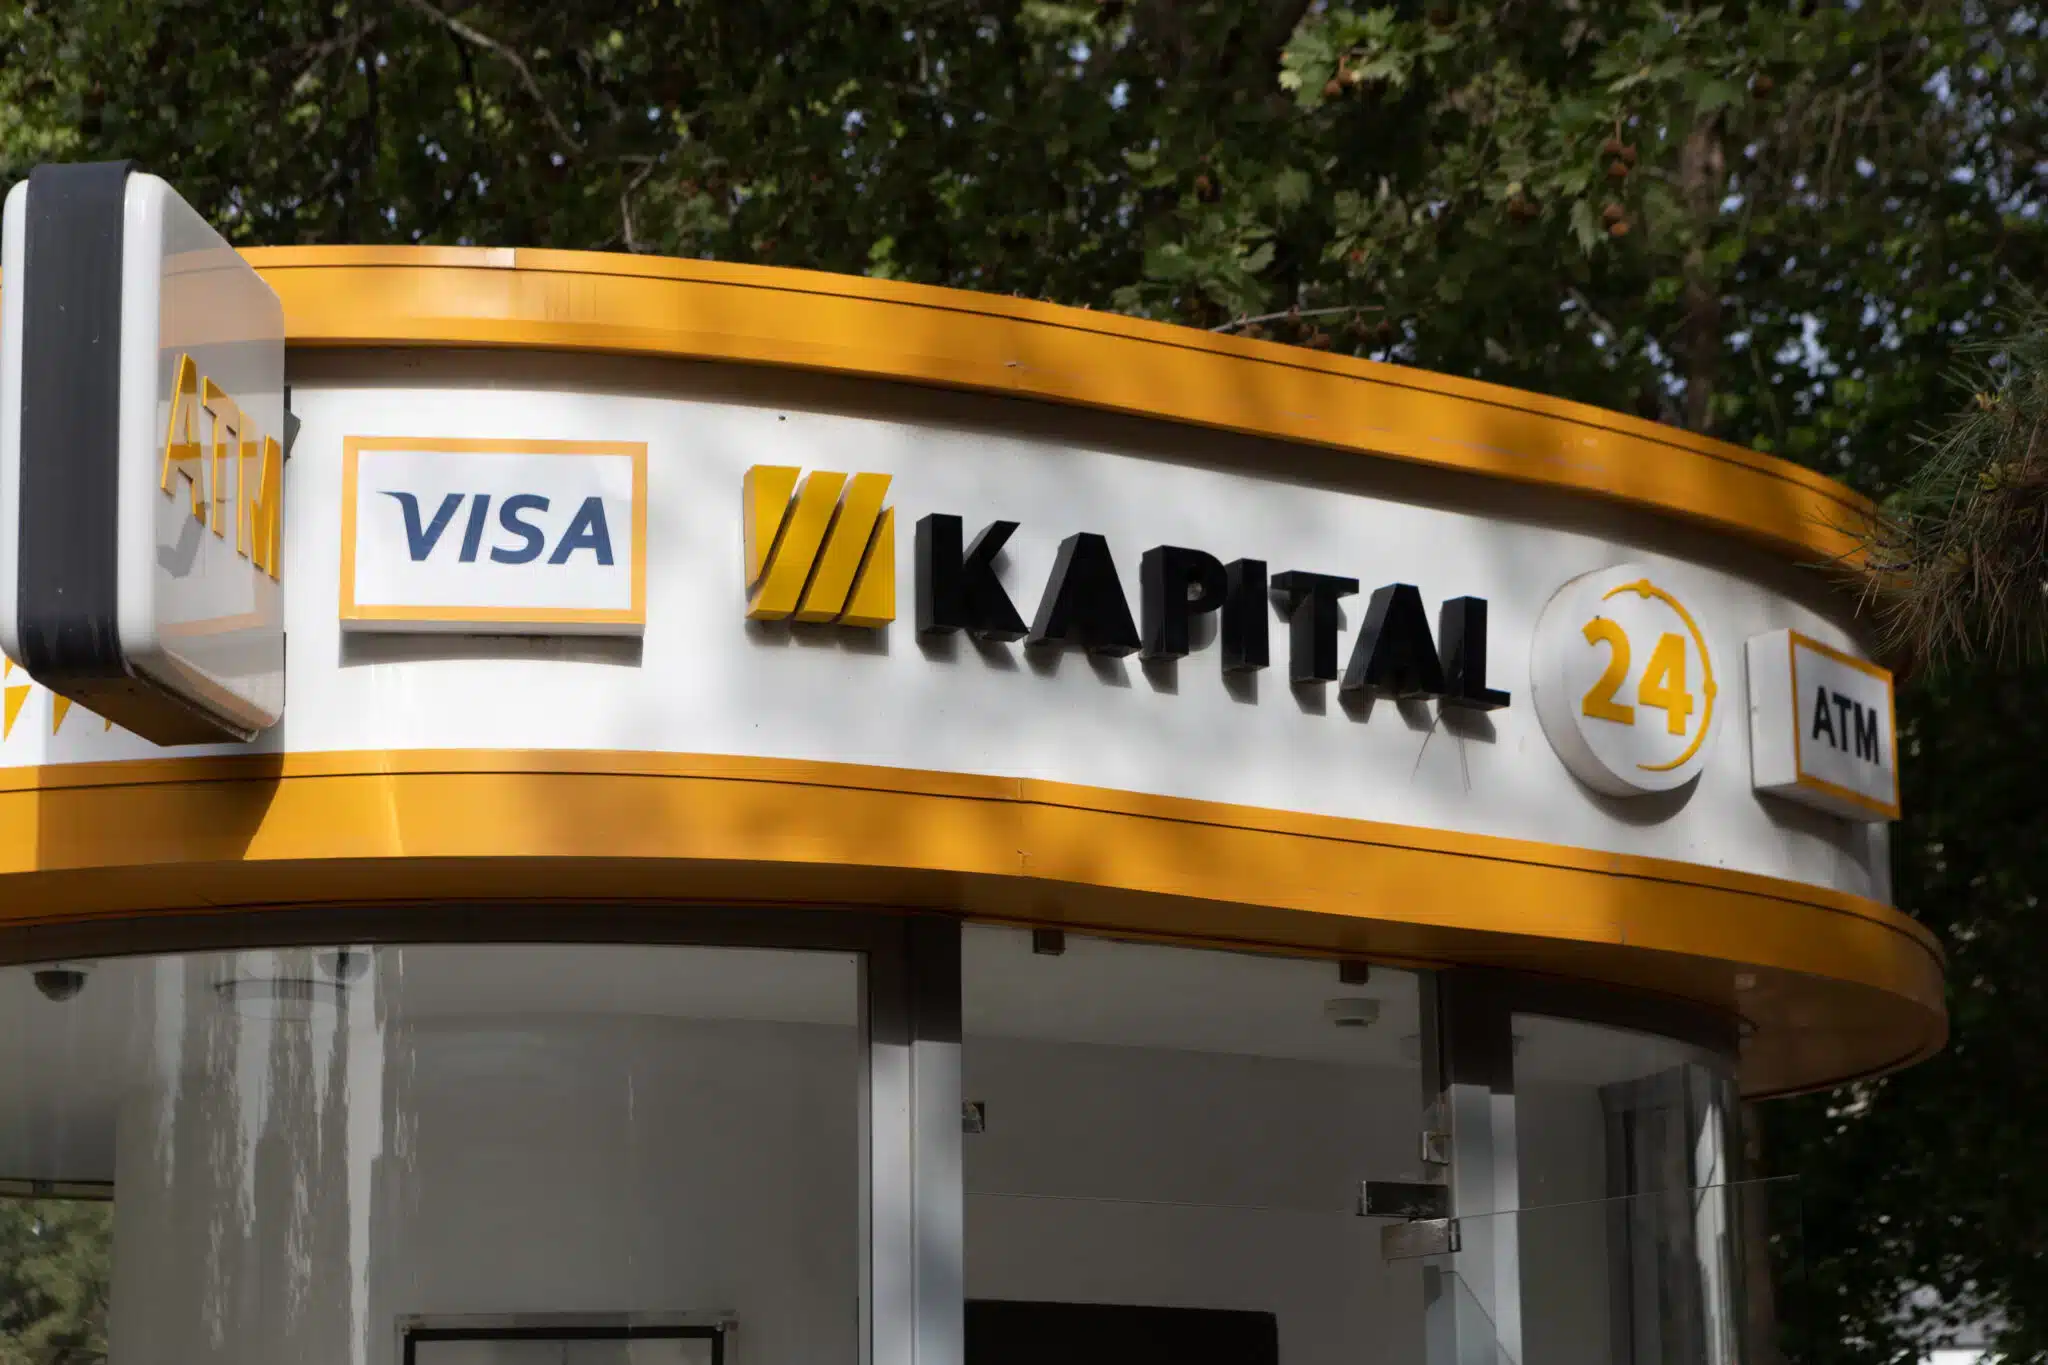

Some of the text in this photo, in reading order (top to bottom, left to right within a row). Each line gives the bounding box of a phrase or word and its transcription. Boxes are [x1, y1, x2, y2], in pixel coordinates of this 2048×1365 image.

[160, 353, 282, 582] ATM
[377, 491, 615, 567] VISA
[915, 513, 1511, 711] KAPITAL
[1581, 616, 1694, 737] 24
[1812, 686, 1880, 766] ATM
